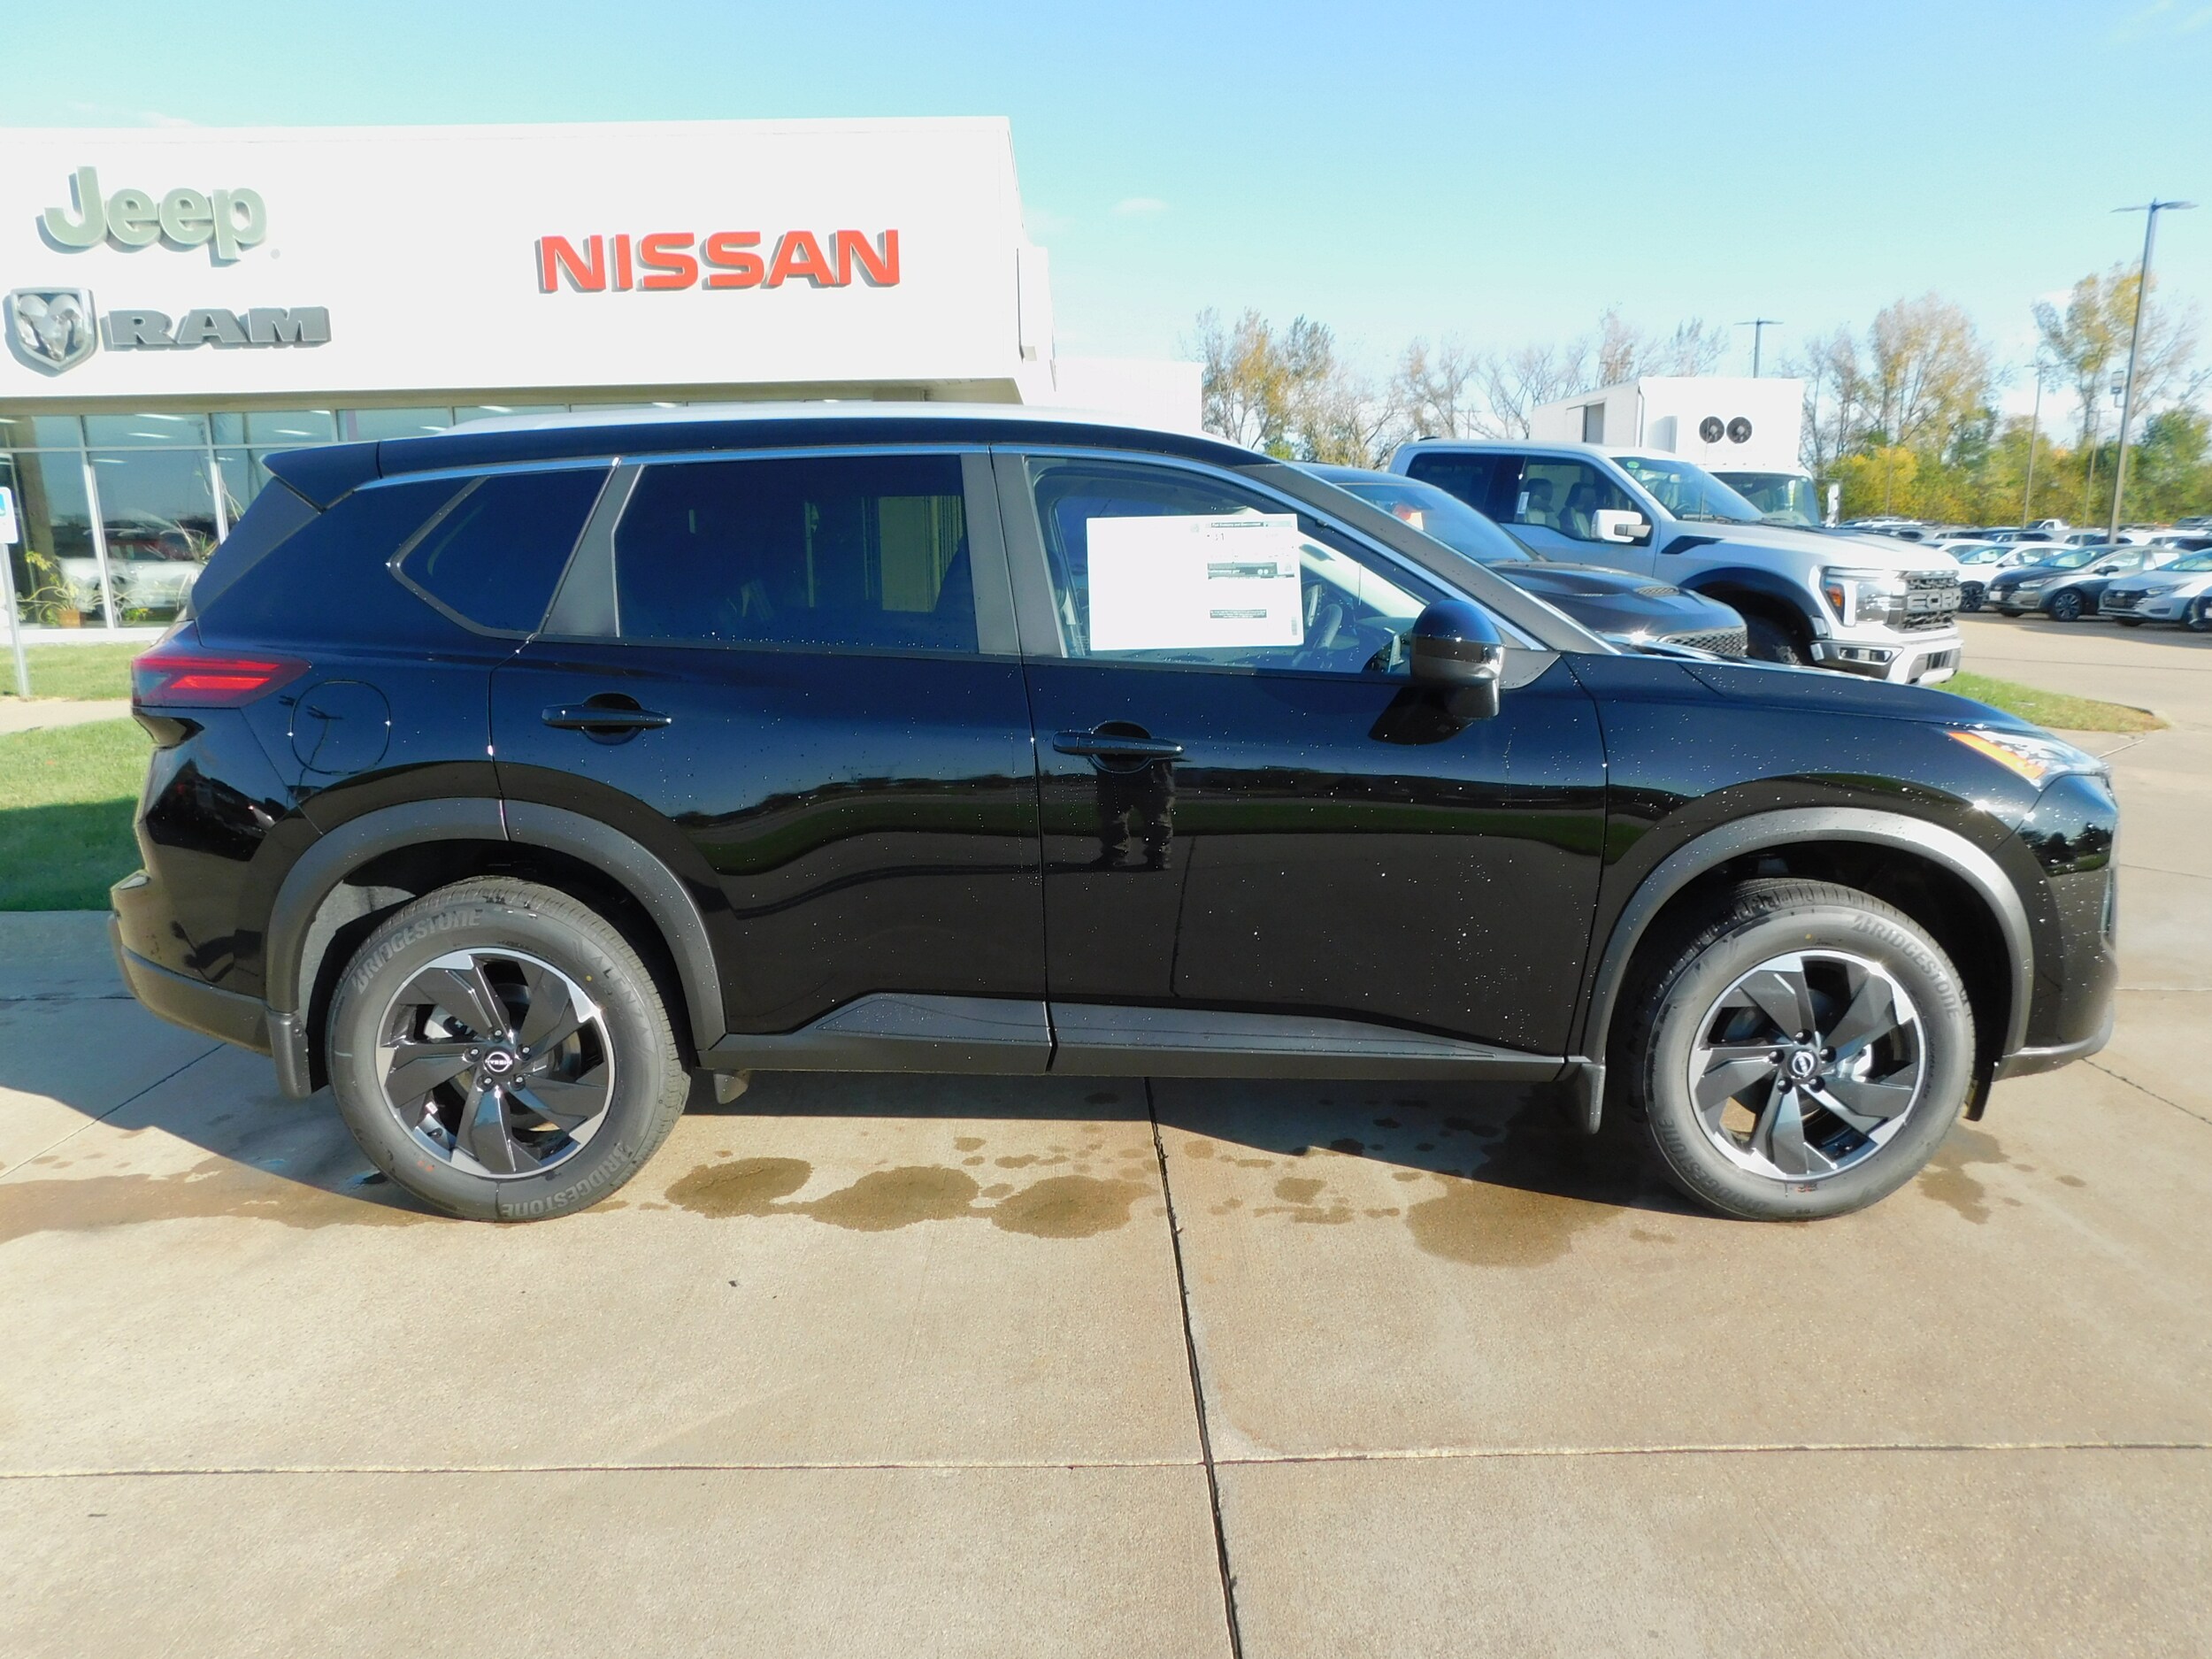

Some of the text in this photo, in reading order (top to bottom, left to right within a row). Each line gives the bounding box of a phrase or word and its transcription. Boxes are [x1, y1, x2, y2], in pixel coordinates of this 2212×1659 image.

[42, 165, 267, 262] Jeep
[539, 228, 900, 292] NISSAN
[105, 306, 332, 348] RAM
[351, 909, 483, 995] BRIDGESTONE
[1850, 914, 1960, 1019] BRIDGESTONE
[502, 1141, 634, 1217] BRIDGESTONE
